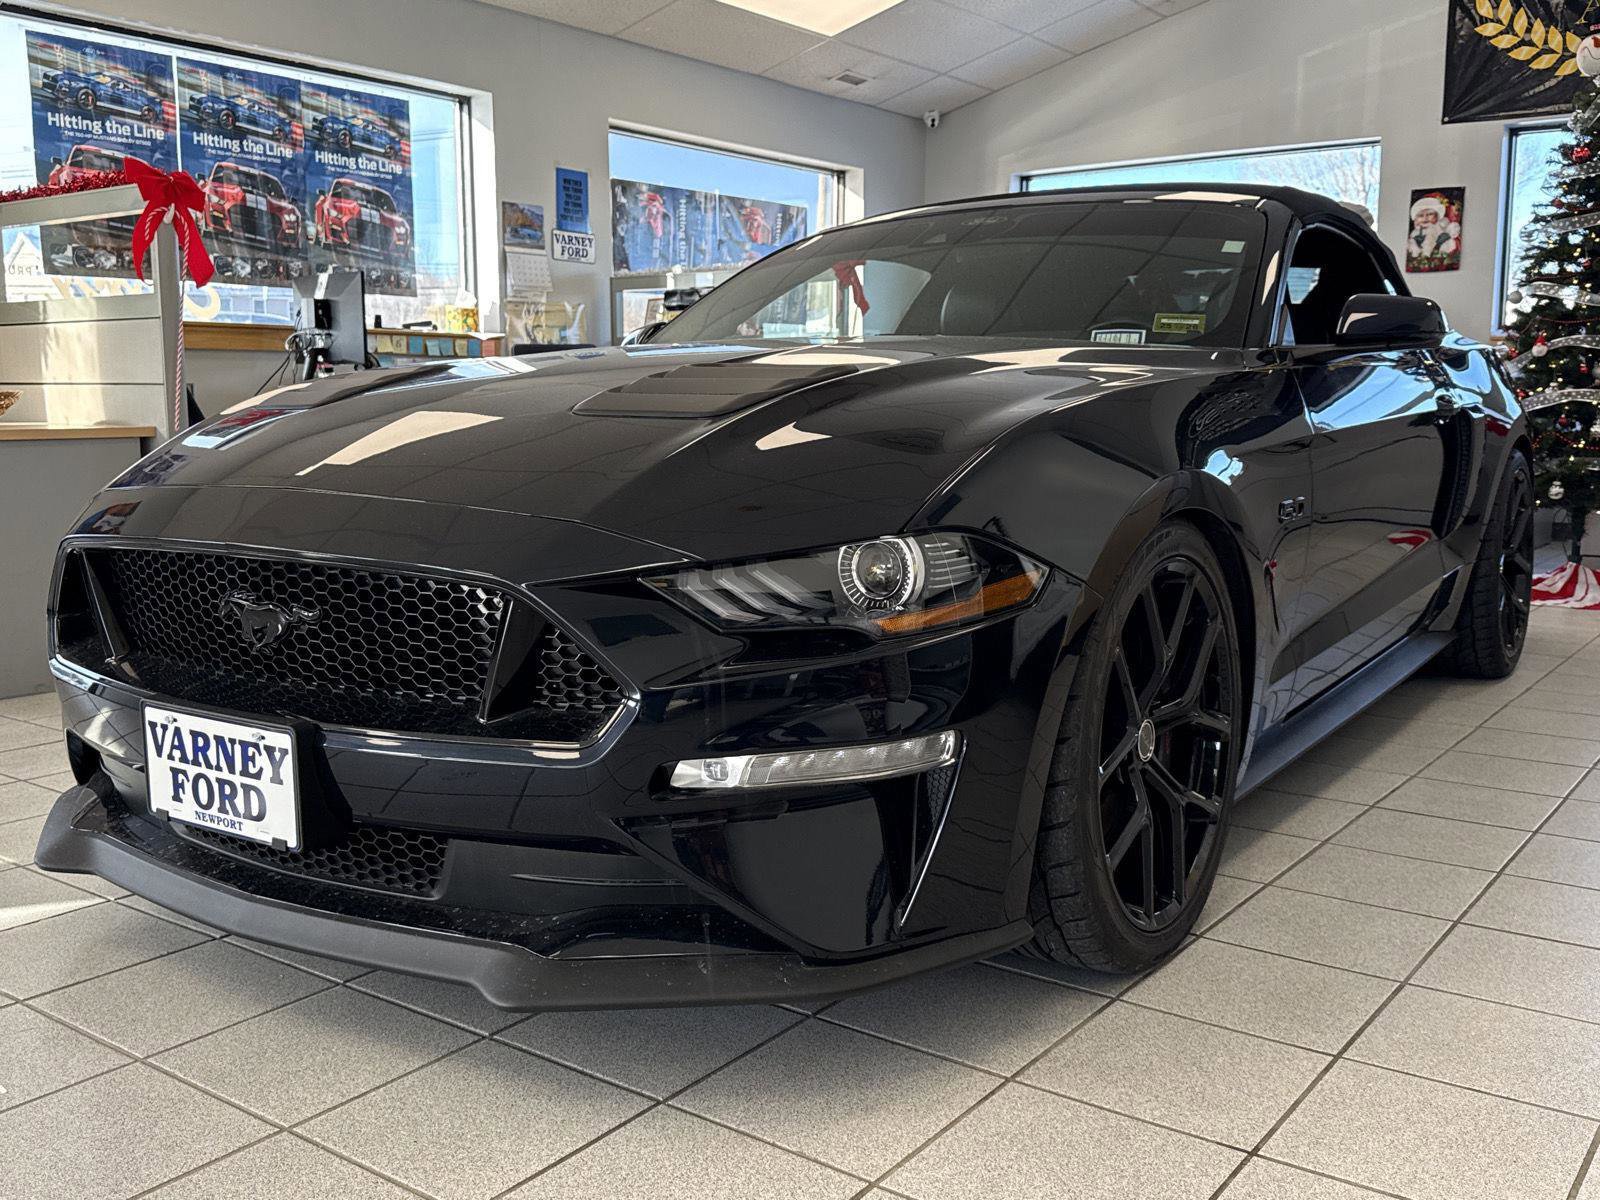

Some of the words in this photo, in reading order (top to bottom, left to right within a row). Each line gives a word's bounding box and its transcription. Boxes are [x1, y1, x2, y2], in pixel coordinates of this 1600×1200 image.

[47, 112, 102, 135] Hitting
[105, 120, 131, 136] the
[134, 124, 165, 140] Line
[193, 131, 241, 153] Hitting
[242, 138, 264, 154] the
[265, 143, 293, 158] Line
[315, 150, 357, 170] Hitting
[358, 156, 378, 171] the
[378, 160, 403, 174] Line
[554, 233, 593, 248] VARNEY
[561, 245, 589, 258] FORD
[148, 720, 289, 786] VARNEY
[169, 766, 267, 822] FORD
[194, 811, 244, 831] NEWPORT
